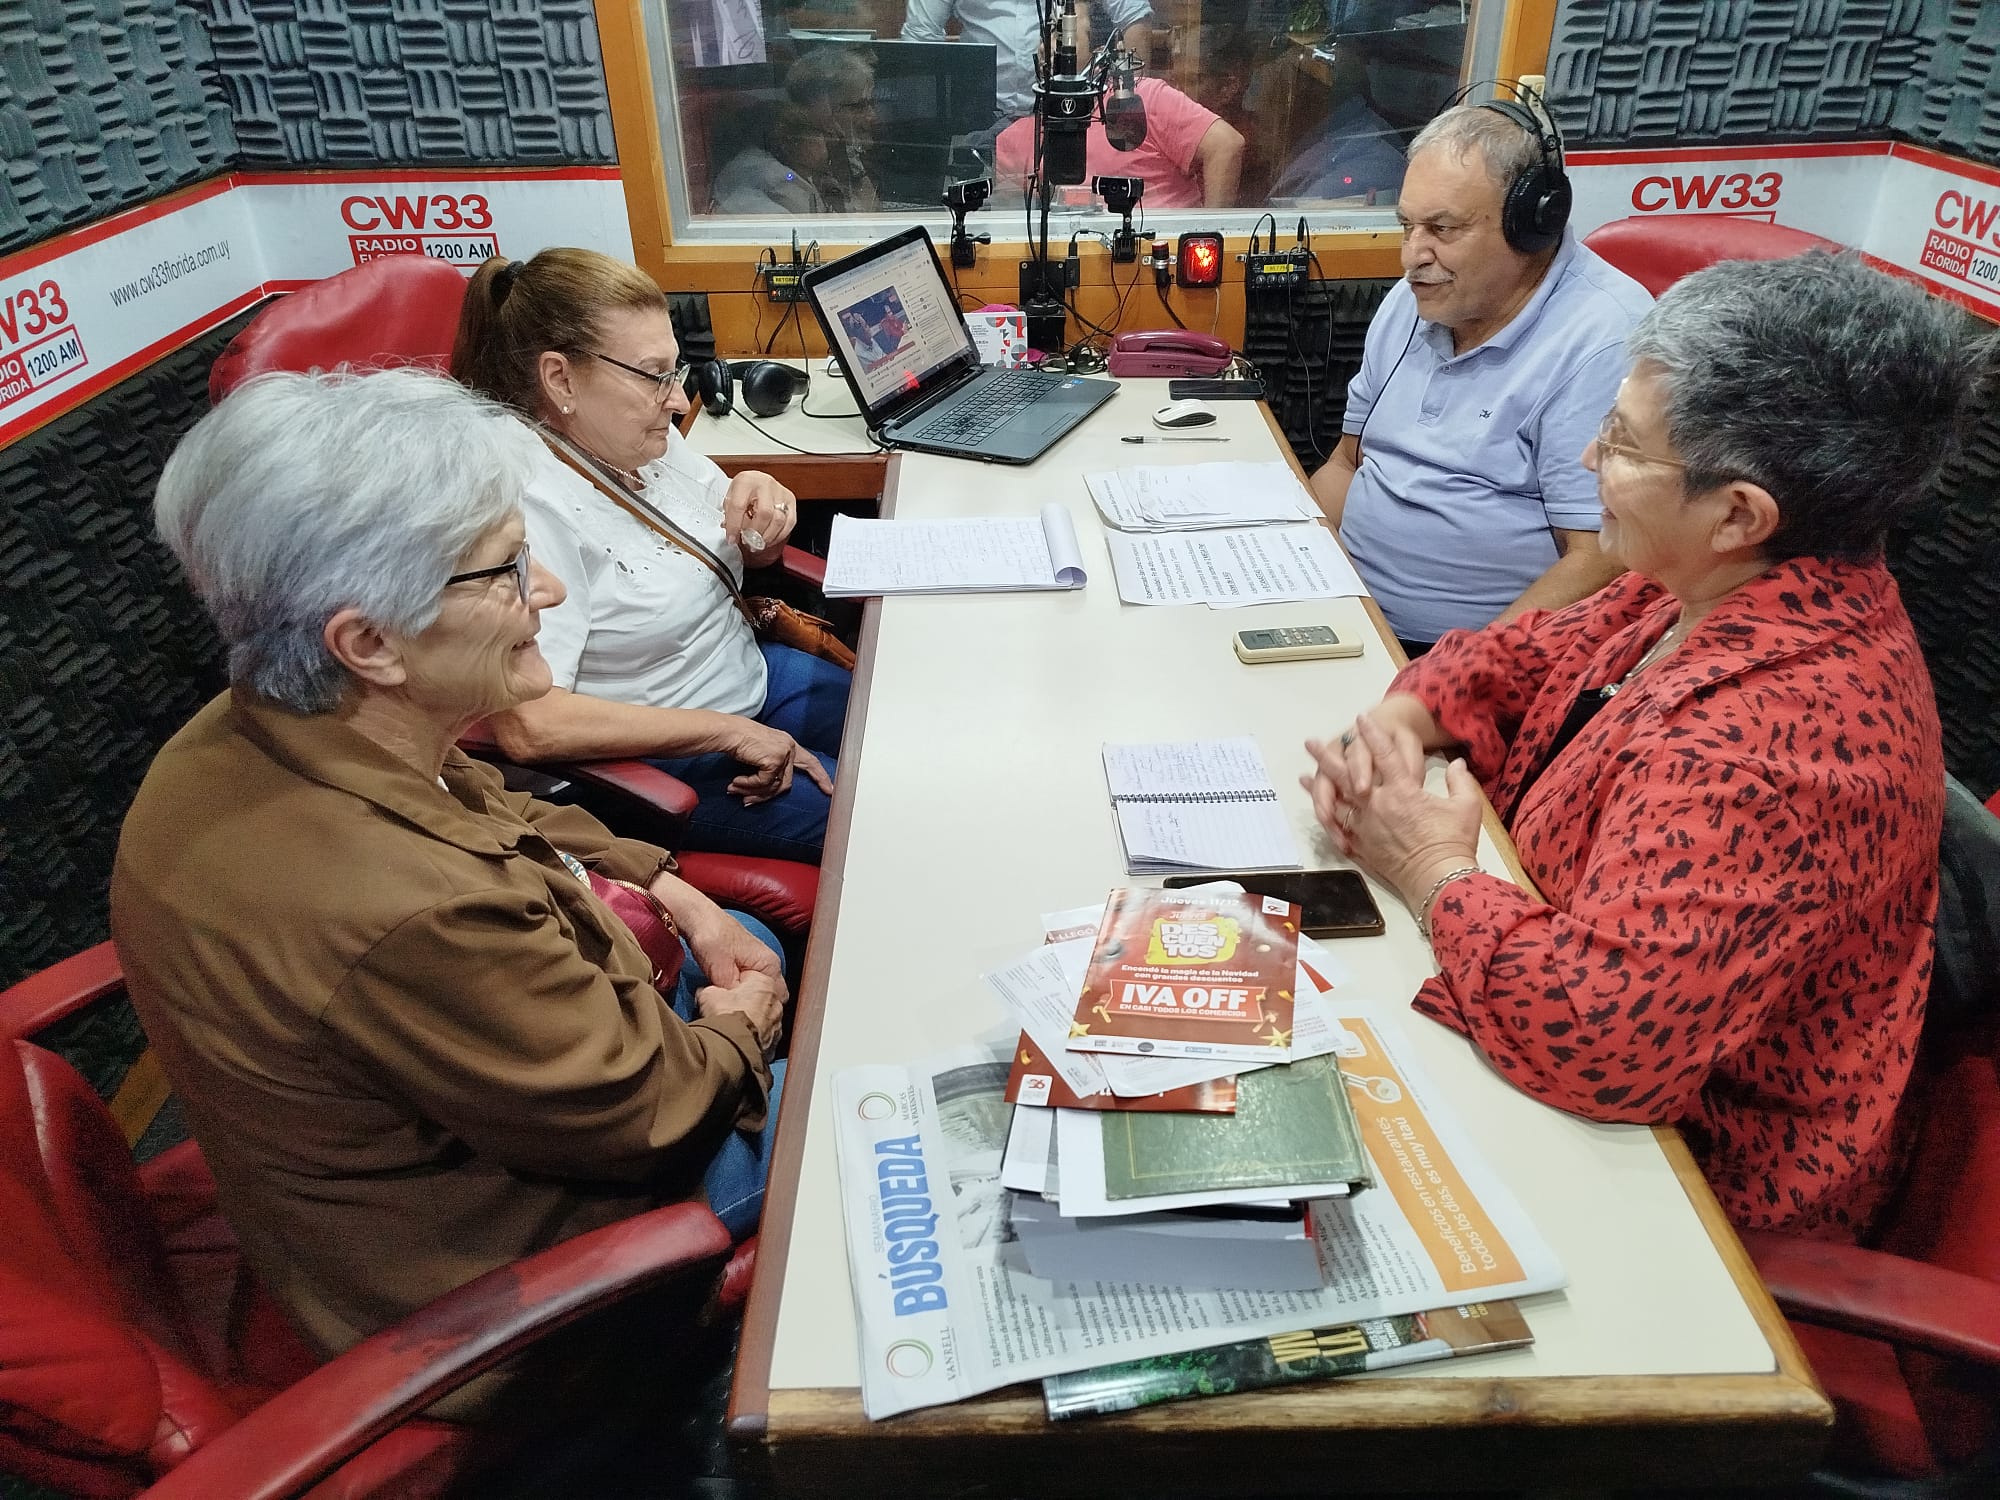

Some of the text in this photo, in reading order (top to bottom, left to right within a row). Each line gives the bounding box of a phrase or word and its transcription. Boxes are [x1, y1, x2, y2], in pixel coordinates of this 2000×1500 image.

[1632, 172, 1783, 212] CW33
[341, 194, 493, 231] CW33
[356, 239, 494, 258] RADIO 1200 AM
[1930, 235, 1970, 260] RADIO
[110, 240, 230, 307] www.cw33florida.com.uy
[1925, 250, 1998, 281] FLORIDA 1200
[28, 350, 57, 378] 1200
[60, 338, 80, 364] AM
[0, 378, 29, 400] RIDA
[1161, 923, 1218, 937] DES
[1162, 934, 1226, 948] CUEN
[1163, 944, 1218, 959] TOS
[1121, 964, 1259, 978] Encendé la magia de la Navidad
[1152, 973, 1188, 982] grandes
[1190, 974, 1243, 983] descuentos
[1122, 983, 1249, 1010] IVA OFF
[1132, 1004, 1152, 1012] CASI
[1181, 1007, 1198, 1015] LOS
[1199, 1008, 1247, 1017] COMERCIOS
[1377, 1118, 1423, 1190] restaurantes
[1392, 1117, 1496, 1270] todos los días, es muy Itaú
[1419, 1192, 1436, 1207] en
[869, 1195, 885, 1253] SEMANARIO
[874, 1134, 948, 1316] BÚSQUEDA
[1430, 1209, 1476, 1273] Beneficios
